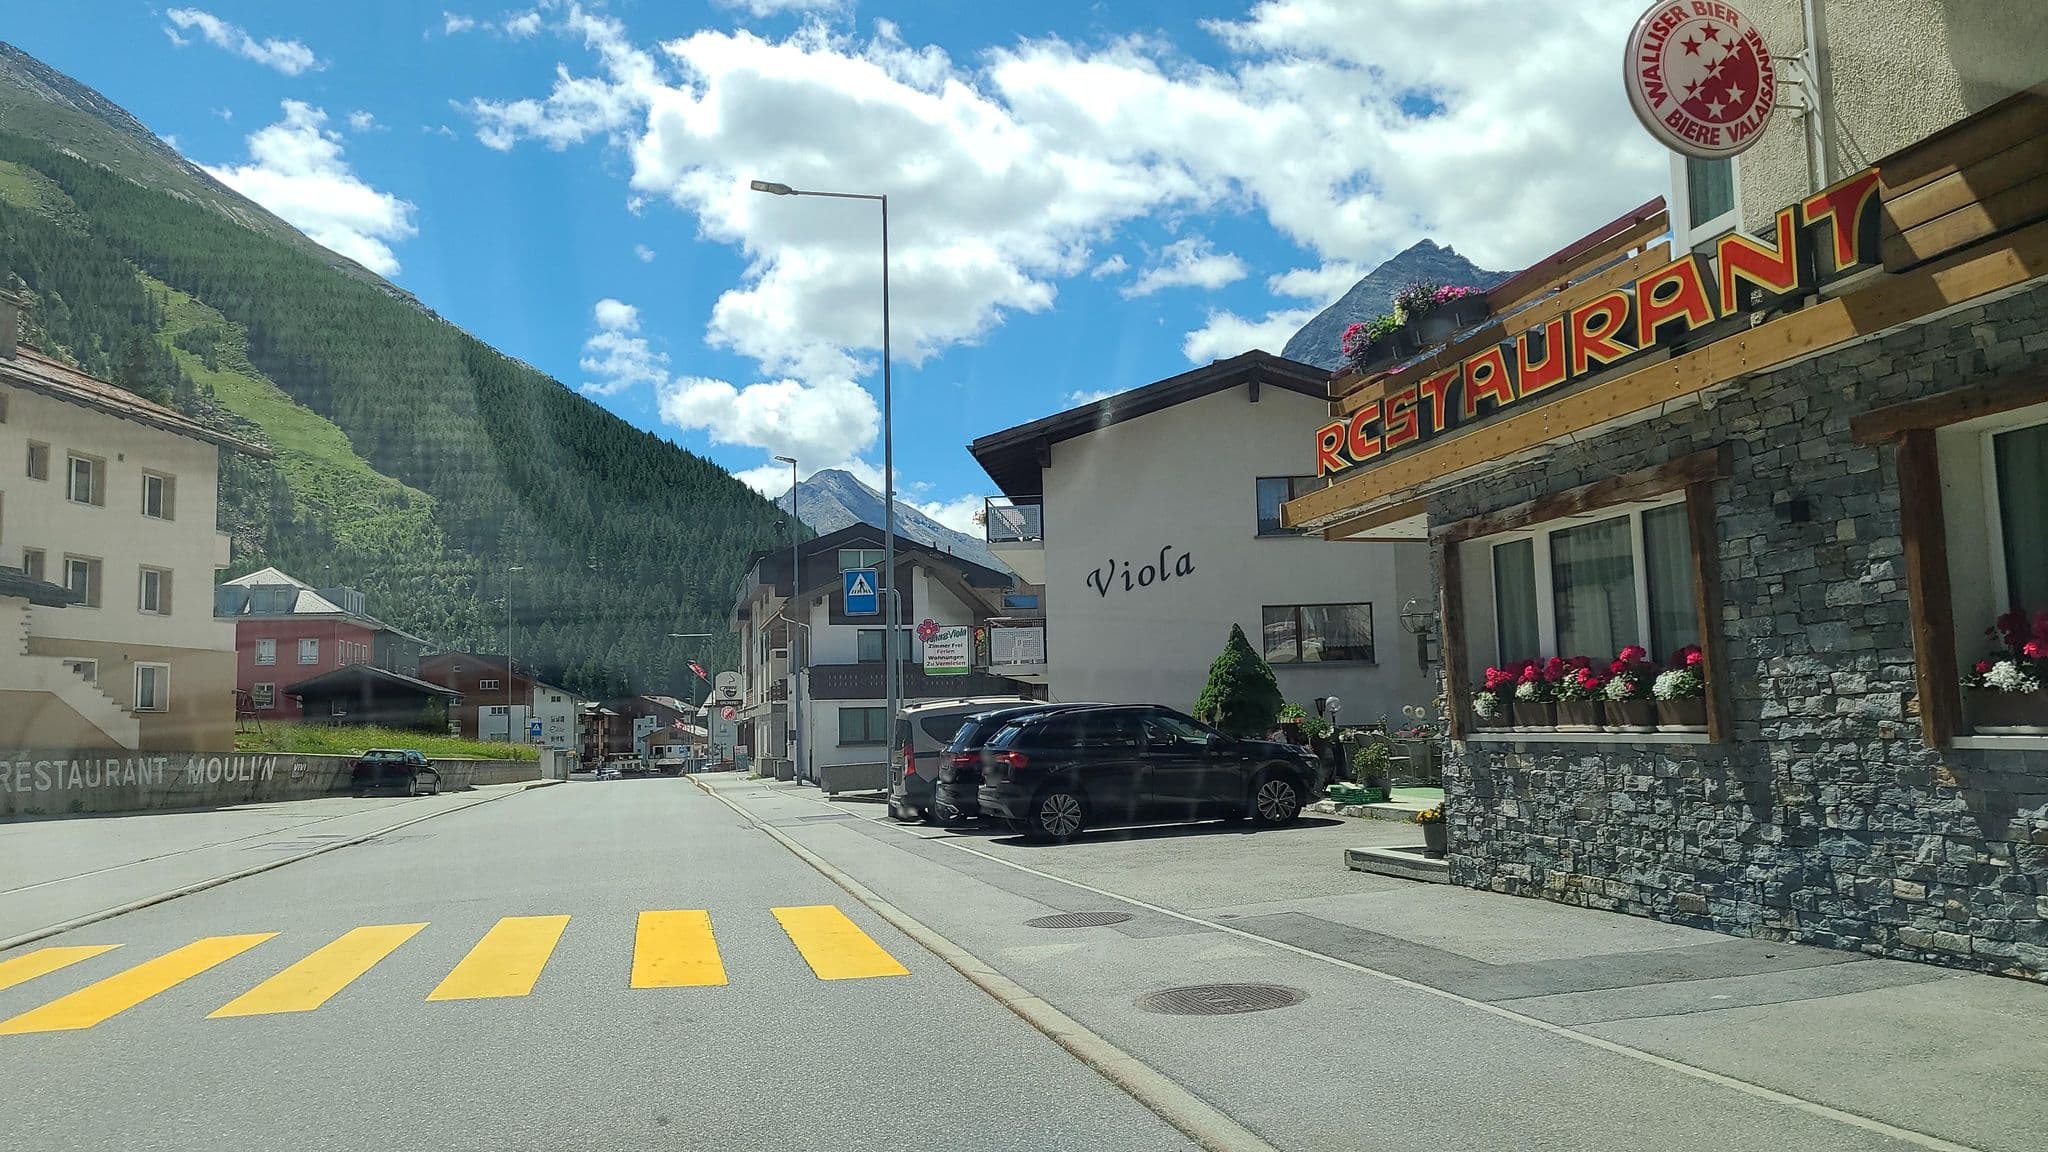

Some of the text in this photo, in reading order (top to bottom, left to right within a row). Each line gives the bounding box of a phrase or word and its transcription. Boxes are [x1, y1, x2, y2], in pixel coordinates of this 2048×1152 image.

[1642, 0, 1739, 109] WALLISER BIER
[1665, 26, 1774, 146] BIERE VALAISANNE
[1315, 167, 1880, 479] RESTAURANT
[1086, 544, 1196, 598] Viola
[0, 757, 168, 793] RESTAURANT
